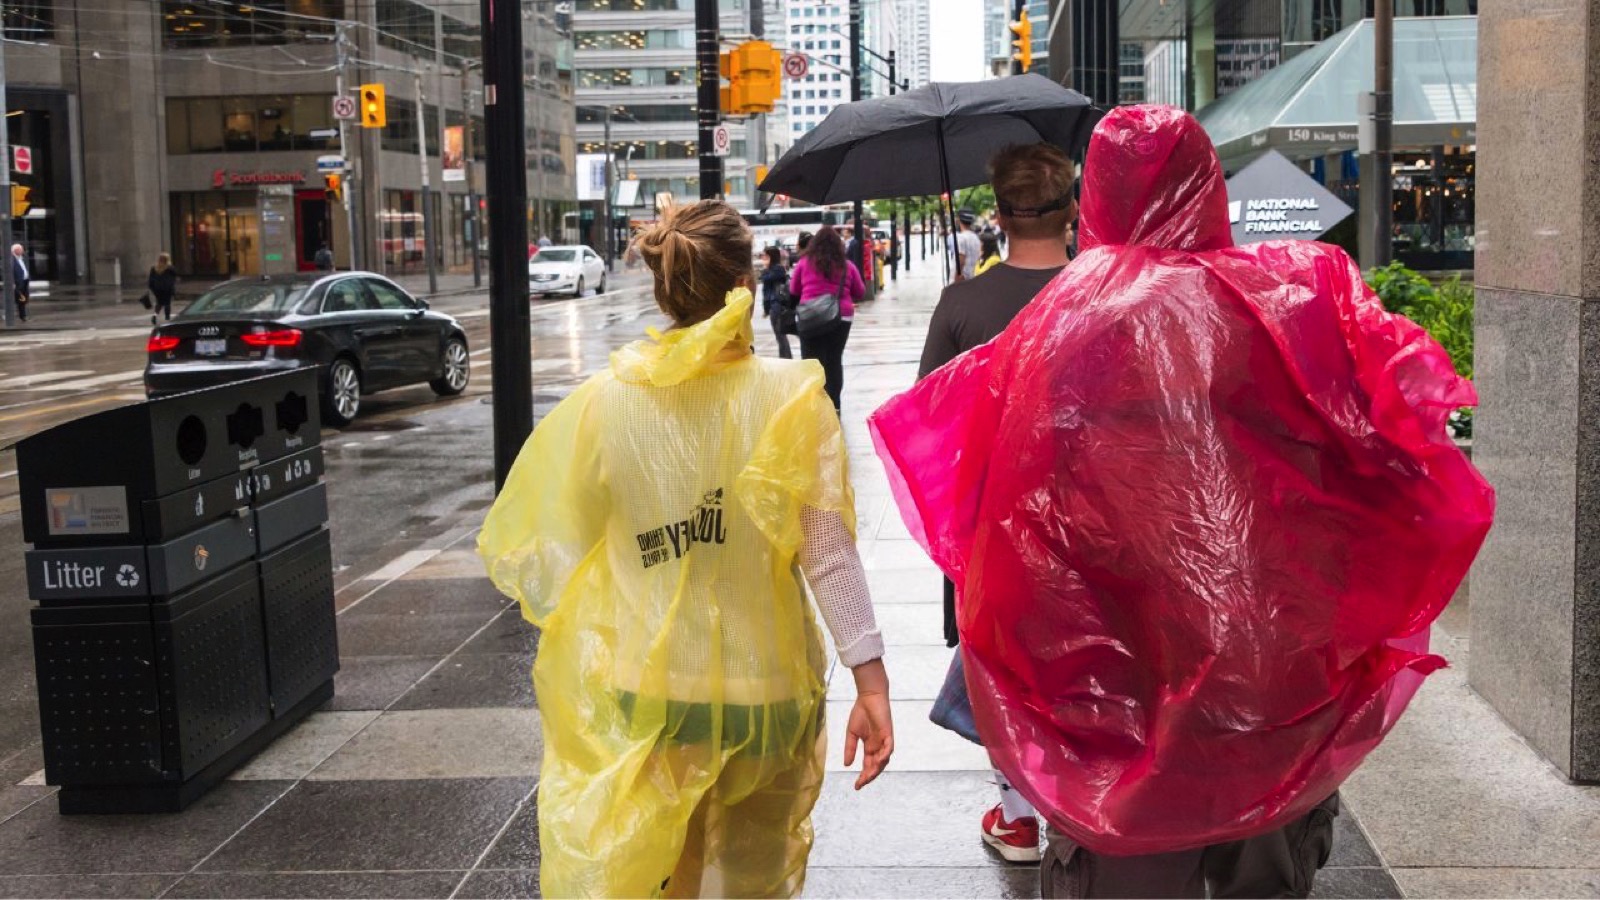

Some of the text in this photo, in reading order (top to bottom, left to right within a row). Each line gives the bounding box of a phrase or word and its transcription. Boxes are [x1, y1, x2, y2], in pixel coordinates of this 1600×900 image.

[1288, 128, 1310, 141] 150
[1313, 130, 1336, 142] King
[1246, 198, 1320, 211] NATIONAL
[1245, 210, 1288, 222] BANK
[1244, 220, 1323, 233] FINANCIAL
[42, 560, 106, 590] Litter
